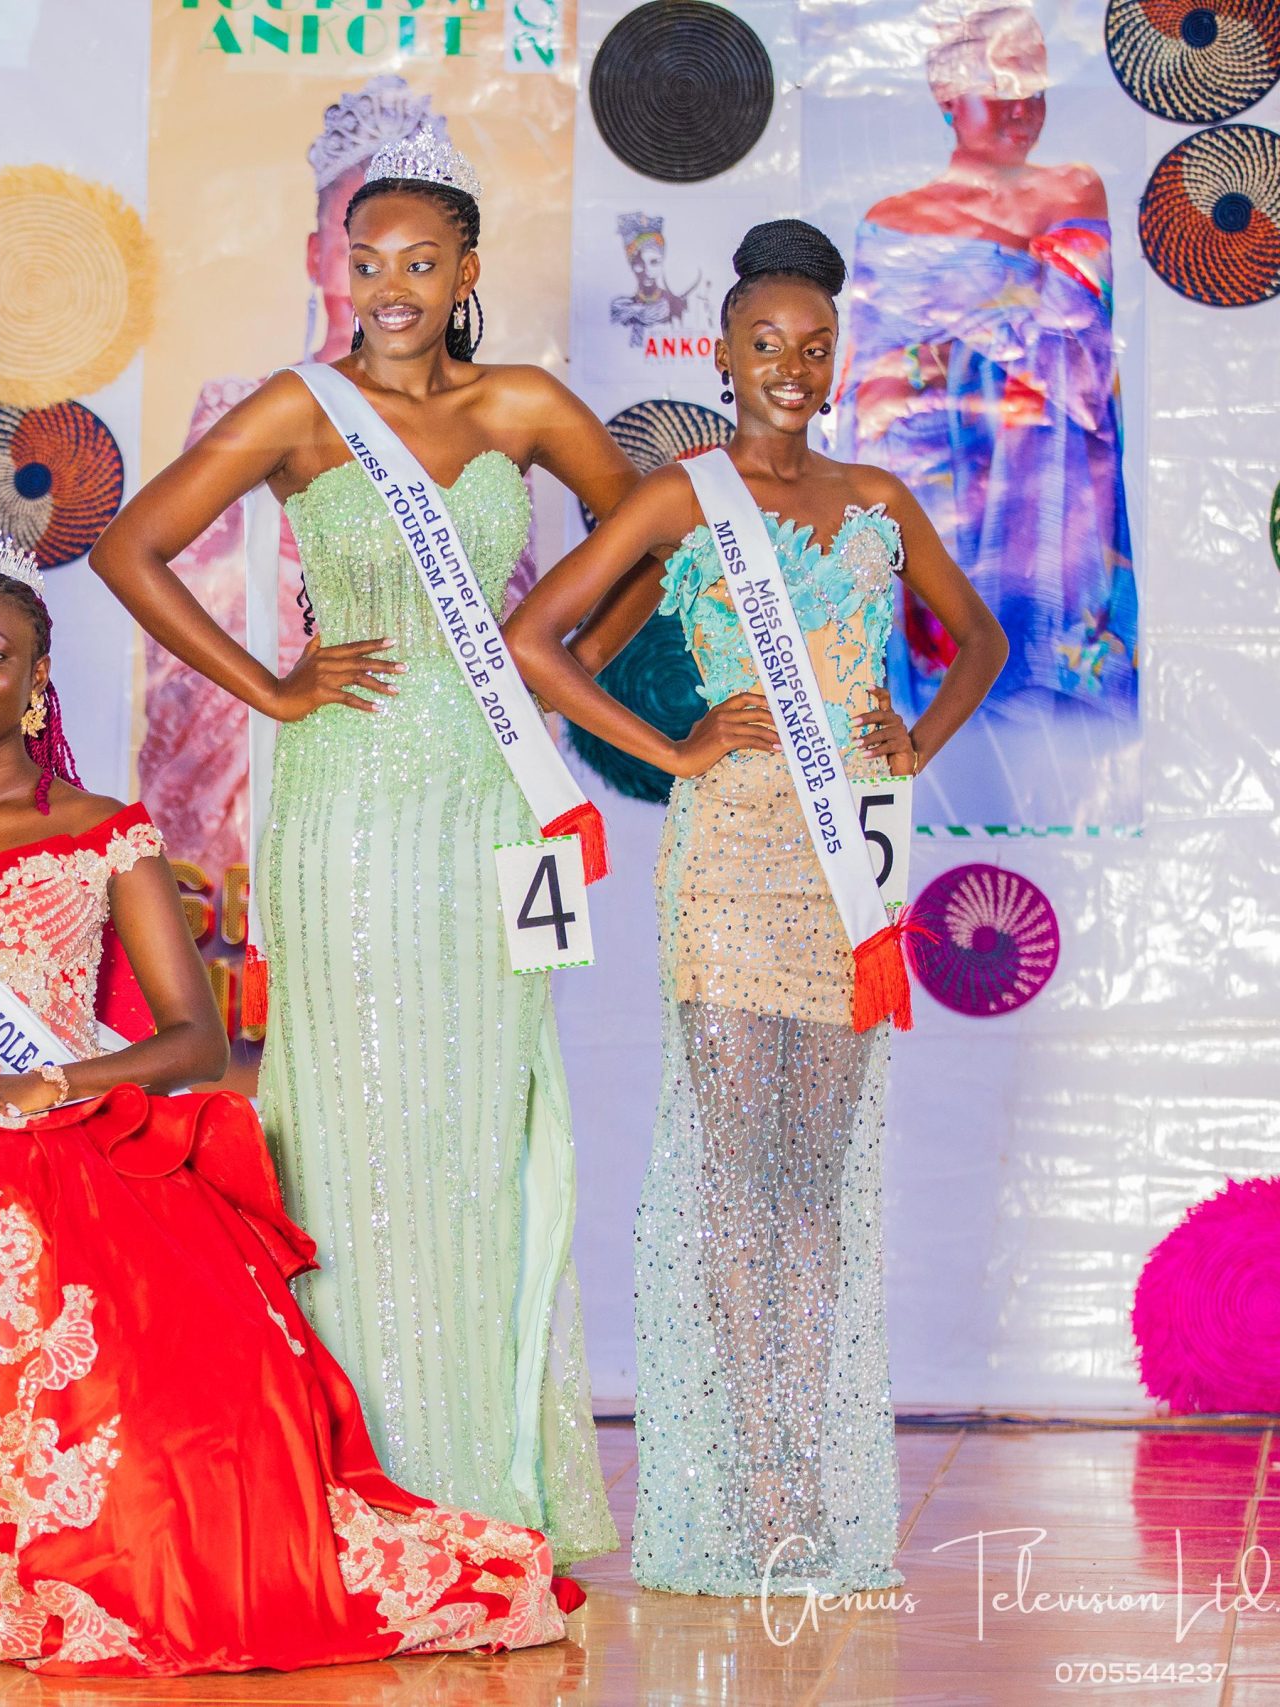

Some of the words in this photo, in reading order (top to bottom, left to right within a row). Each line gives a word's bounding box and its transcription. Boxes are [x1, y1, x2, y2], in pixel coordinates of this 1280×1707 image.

[198, 13, 478, 57] ANKOLE
[645, 337, 711, 358] ANKO
[345, 431, 388, 482] MISS
[384, 483, 447, 590] TOURISM
[437, 594, 490, 688] ANKOLE
[481, 691, 519, 746] 2025
[407, 481, 441, 525] 2nd
[483, 637, 505, 671] Up
[714, 519, 747, 576] MISS
[737, 580, 787, 691] TOURISM
[778, 697, 824, 792] ANKOLE
[813, 797, 842, 855] 2025
[755, 578, 783, 631] Miss
[775, 634, 836, 783] Conservation
[517, 854, 576, 950] 4
[858, 794, 895, 889] 5
